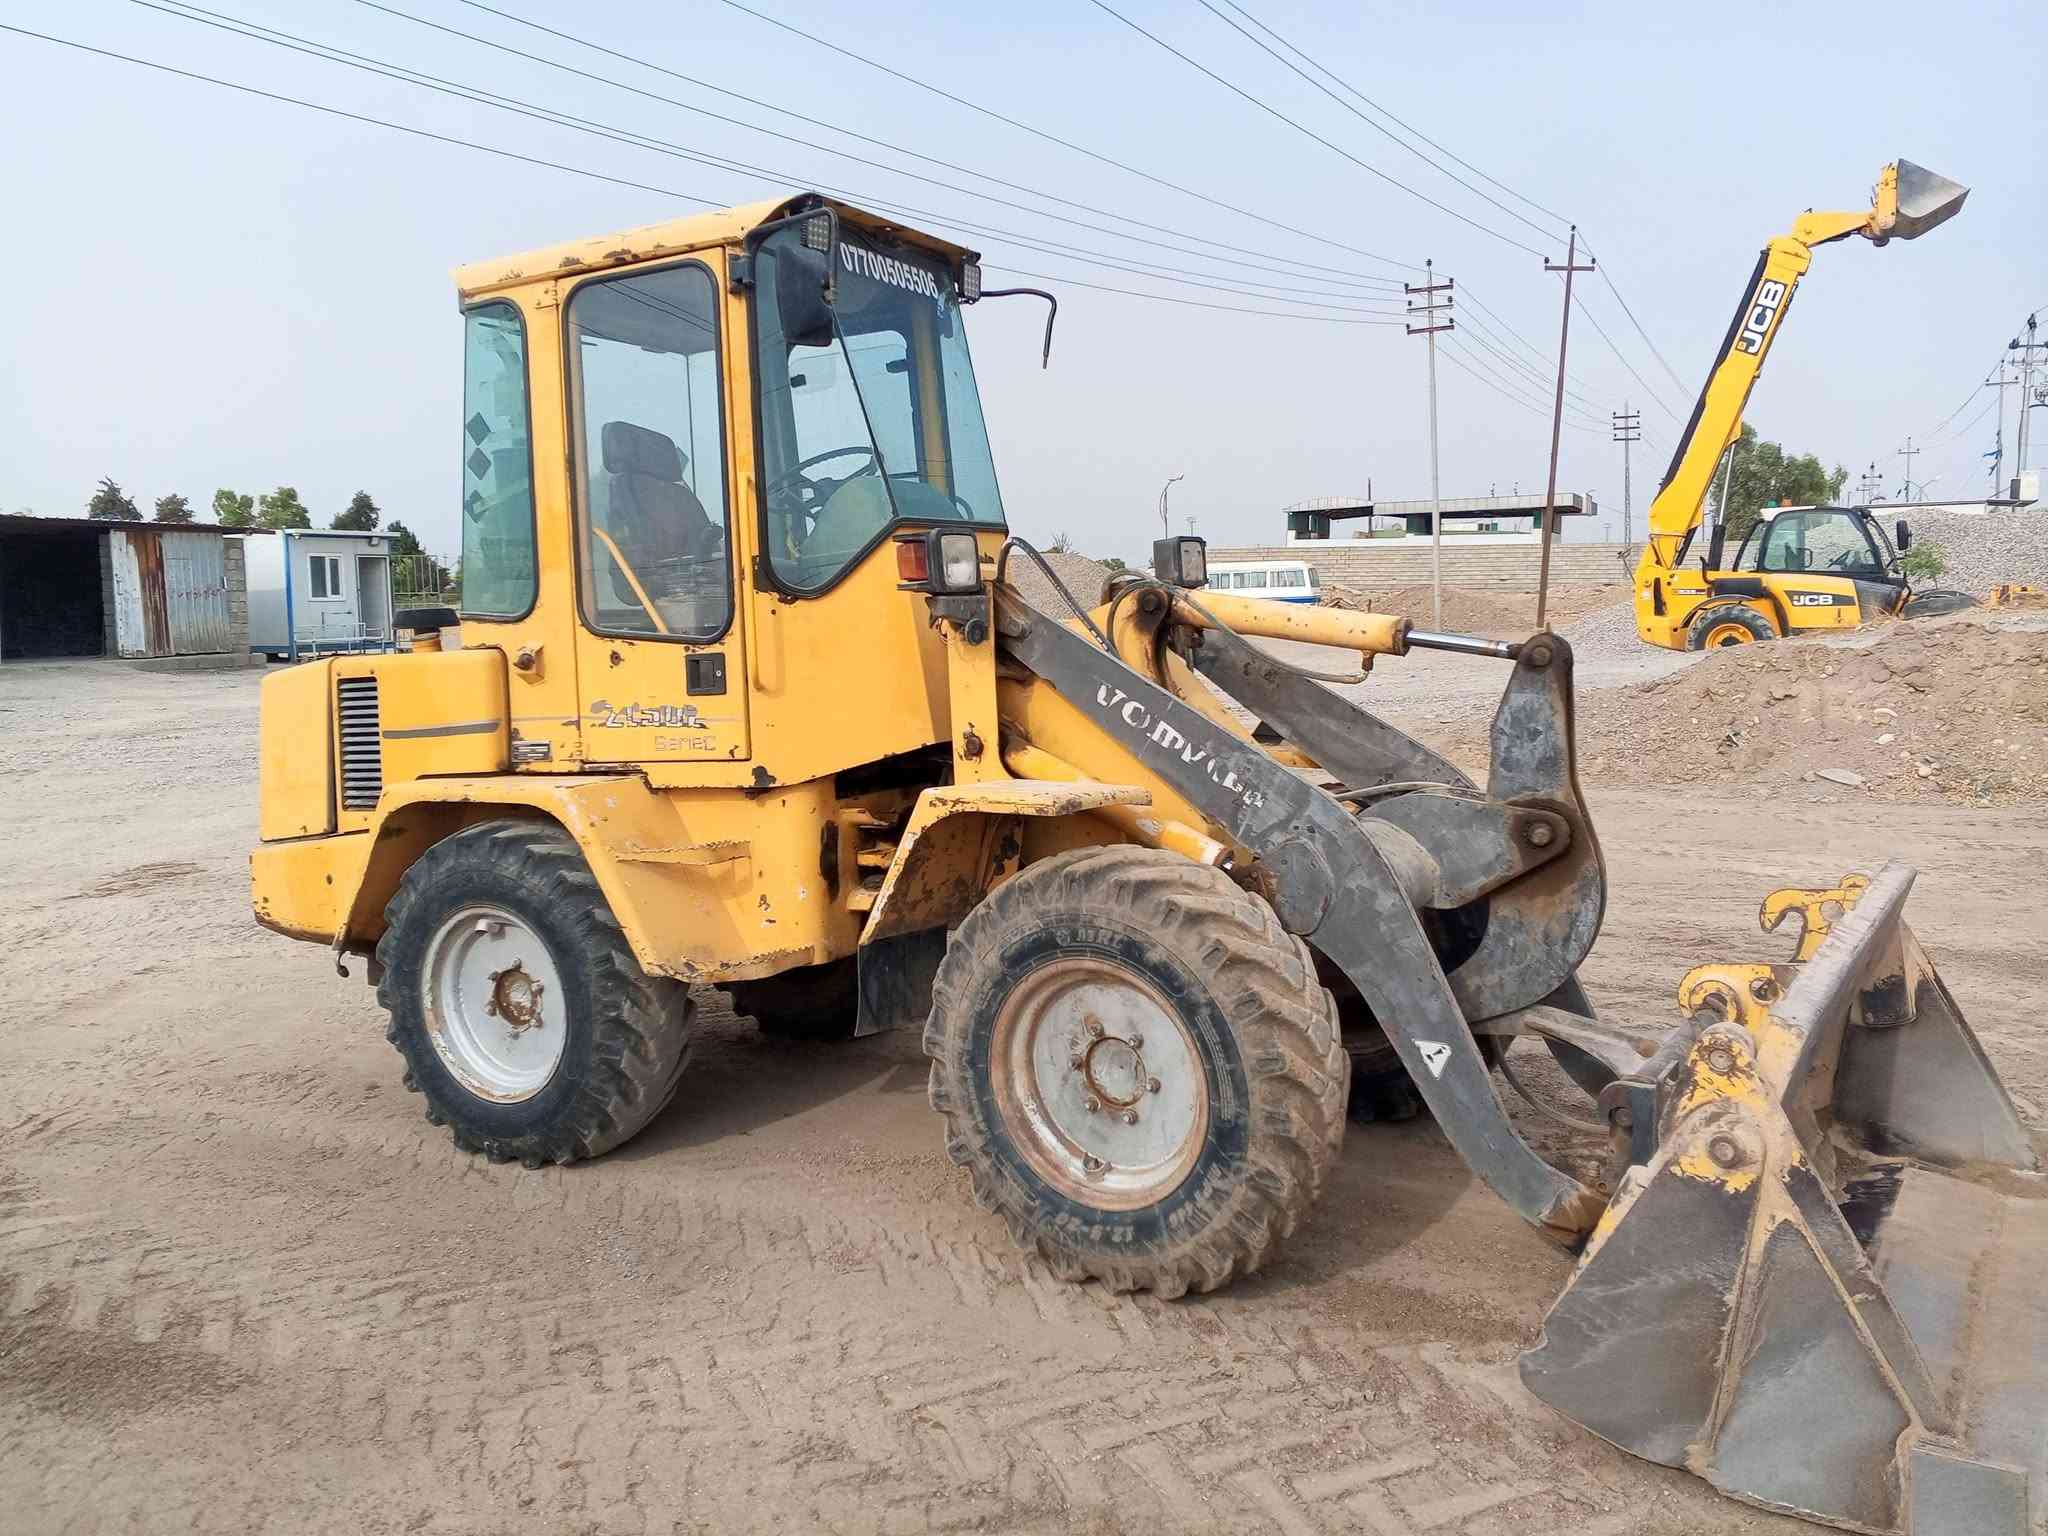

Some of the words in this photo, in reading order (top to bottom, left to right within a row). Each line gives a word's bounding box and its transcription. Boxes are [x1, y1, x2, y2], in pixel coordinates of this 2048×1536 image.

[840, 240, 939, 299] 07700505506
[1735, 280, 1786, 354] JCB
[1792, 594, 1833, 606] JCB
